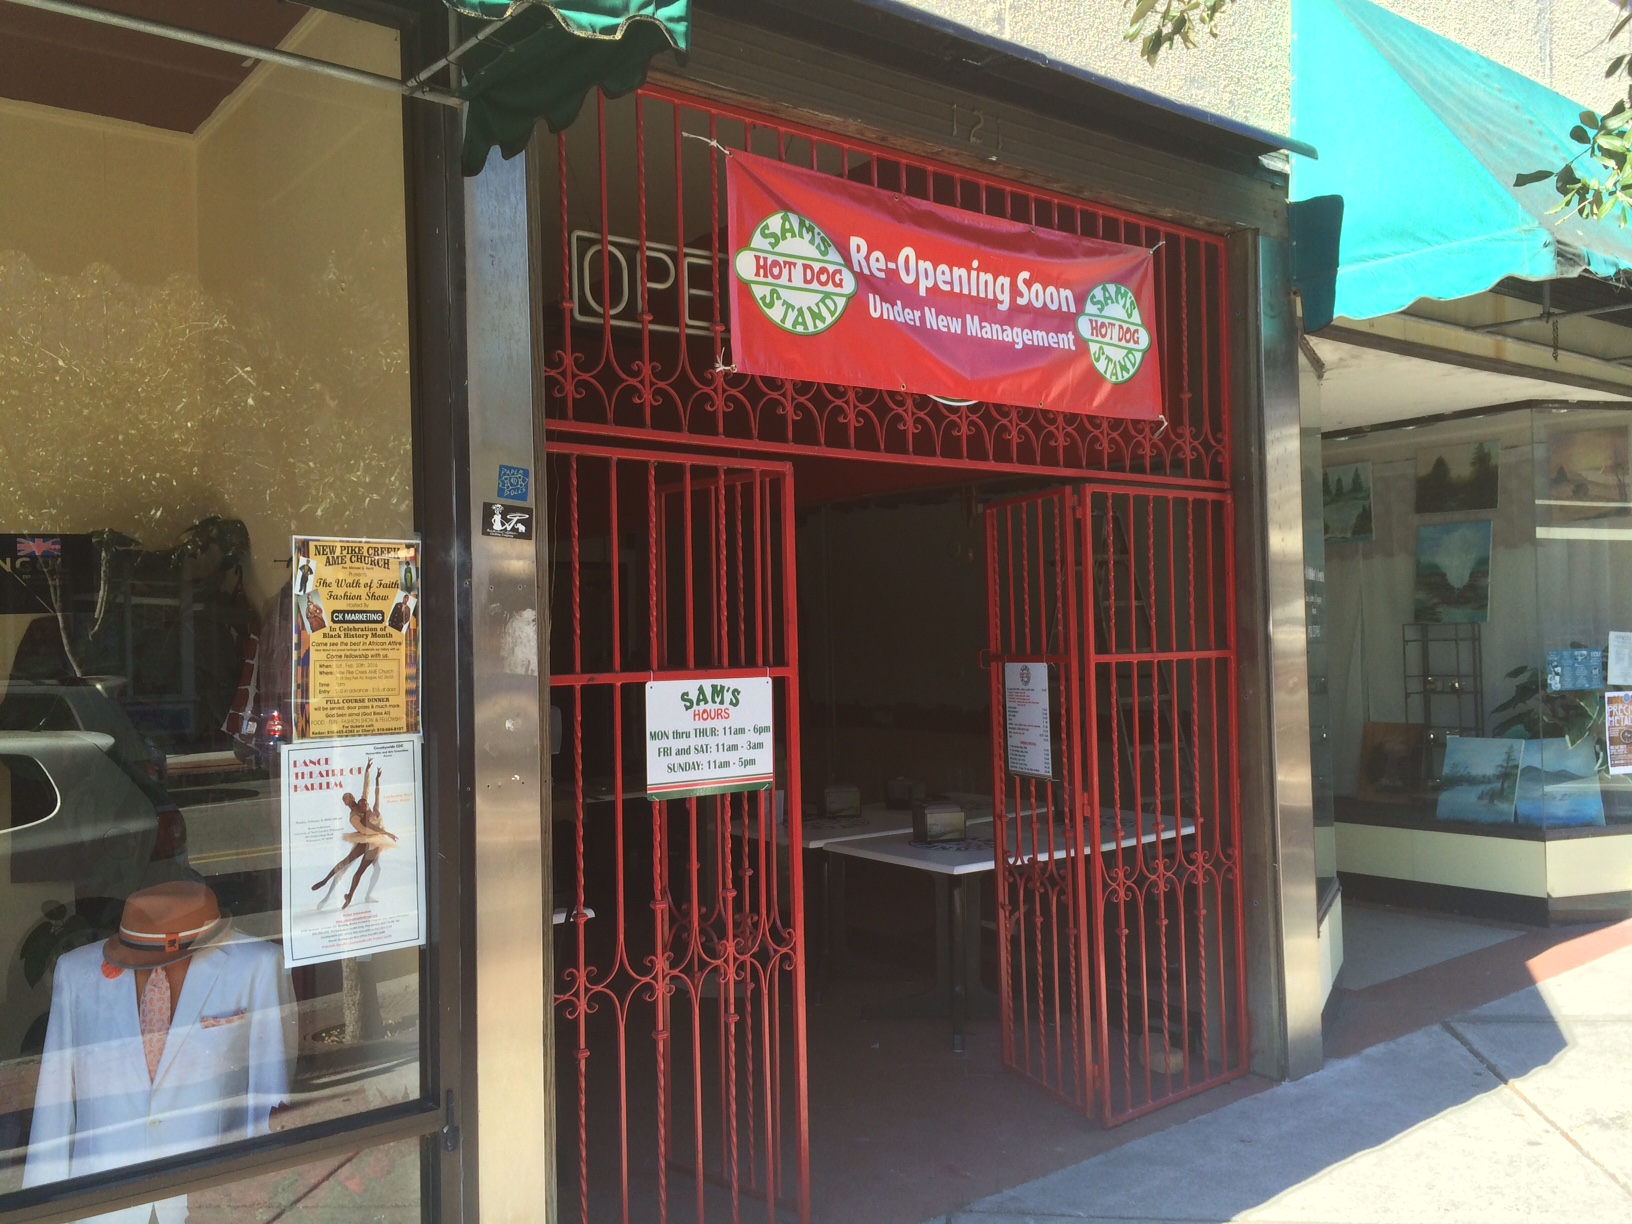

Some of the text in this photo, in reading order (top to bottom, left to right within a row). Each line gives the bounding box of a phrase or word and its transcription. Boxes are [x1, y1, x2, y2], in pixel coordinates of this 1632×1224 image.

[760, 212, 831, 257] SAM'S
[754, 254, 844, 289] HOT DOG
[850, 236, 1076, 313] Re-Opening Soon
[583, 243, 714, 327] OPE
[760, 288, 838, 331] STAND
[1090, 284, 1136, 319] SAM'S
[868, 293, 1076, 350] Under New Management
[1088, 318, 1140, 345] HOT DOG
[1093, 345, 1136, 380] STAND
[501, 468, 524, 476] PAPER
[314, 545, 337, 556] NEW
[340, 546, 364, 555] PIKE
[325, 555, 390, 570] AME CHURCH
[315, 578, 400, 592] The Walk of Faith
[326, 590, 389, 600] Fashion Show
[680, 684, 741, 711] SAM'S
[693, 708, 730, 721] HOURS
[649, 730, 669, 741] MON
[672, 729, 690, 739] thru
[693, 727, 719, 738] THUR:
[722, 726, 746, 736] 11am
[753, 724, 771, 735] 6pm
[658, 747, 672, 757] FRI
[675, 745, 691, 756] and
[693, 744, 712, 754] SAT:
[715, 742, 738, 752] 11am
[746, 740, 764, 750] 3am
[293, 757, 331, 768] DANCE
[667, 761, 704, 773] SUNDAY:
[707, 760, 730, 769] 11am
[738, 757, 756, 768] 5pm
[294, 766, 363, 780] THEATRE OF
[294, 780, 344, 792] HARLEM
